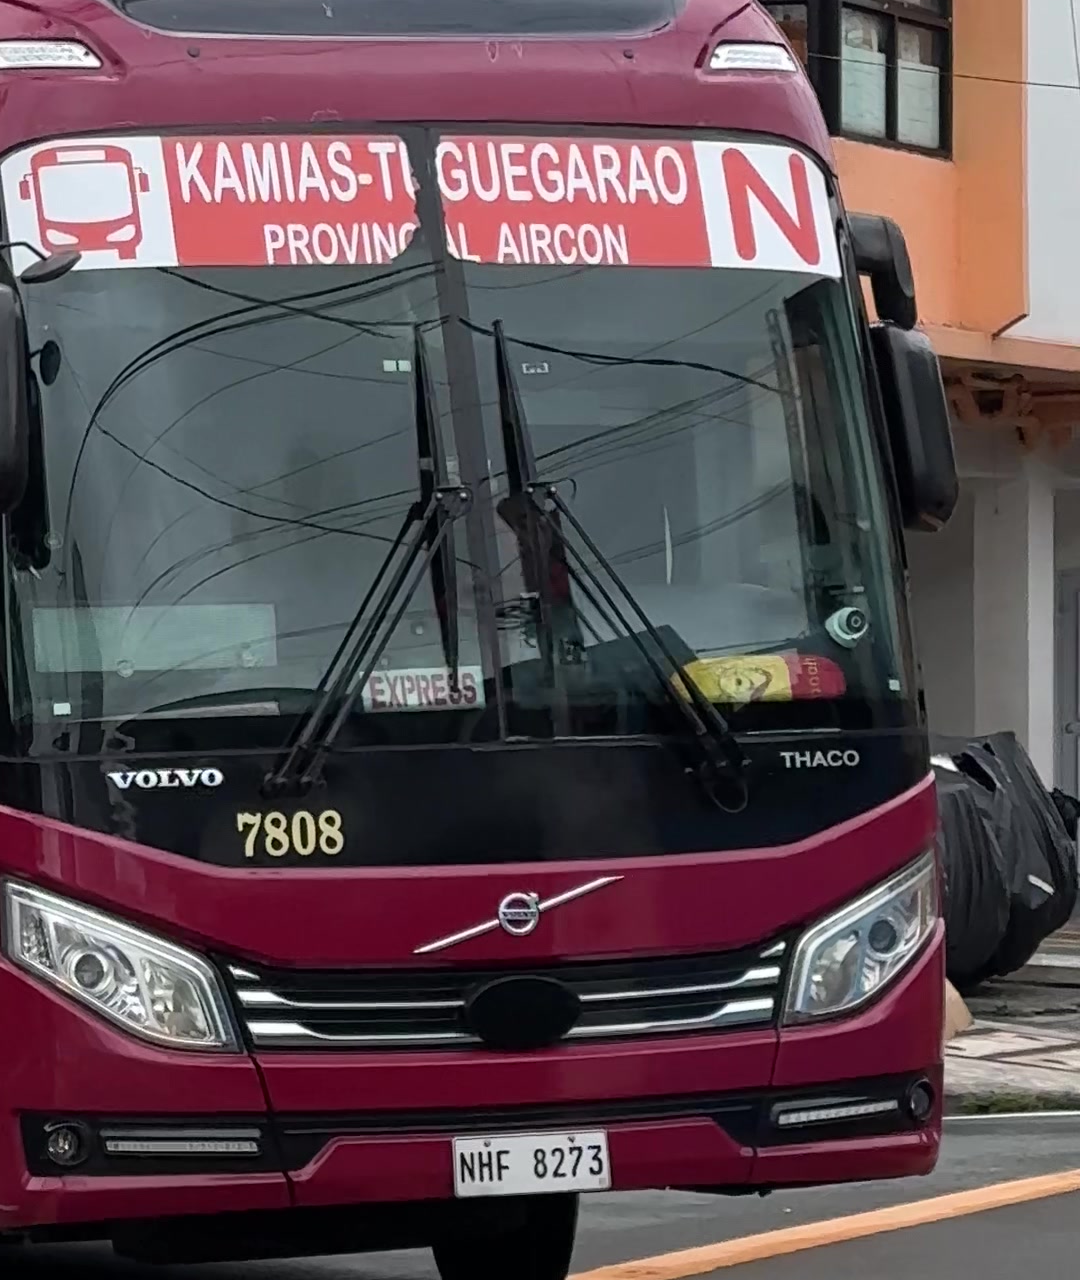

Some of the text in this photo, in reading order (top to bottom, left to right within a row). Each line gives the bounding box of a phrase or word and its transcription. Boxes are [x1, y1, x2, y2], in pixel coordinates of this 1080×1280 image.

[721, 147, 821, 266] N
[497, 223, 629, 265] AIRCON
[370, 672, 478, 708] EXPRESS
[108, 768, 224, 789] VOLVO
[780, 750, 860, 768] THACO
[236, 809, 345, 858] 7808
[460, 1145, 604, 1184] NHF 8273
